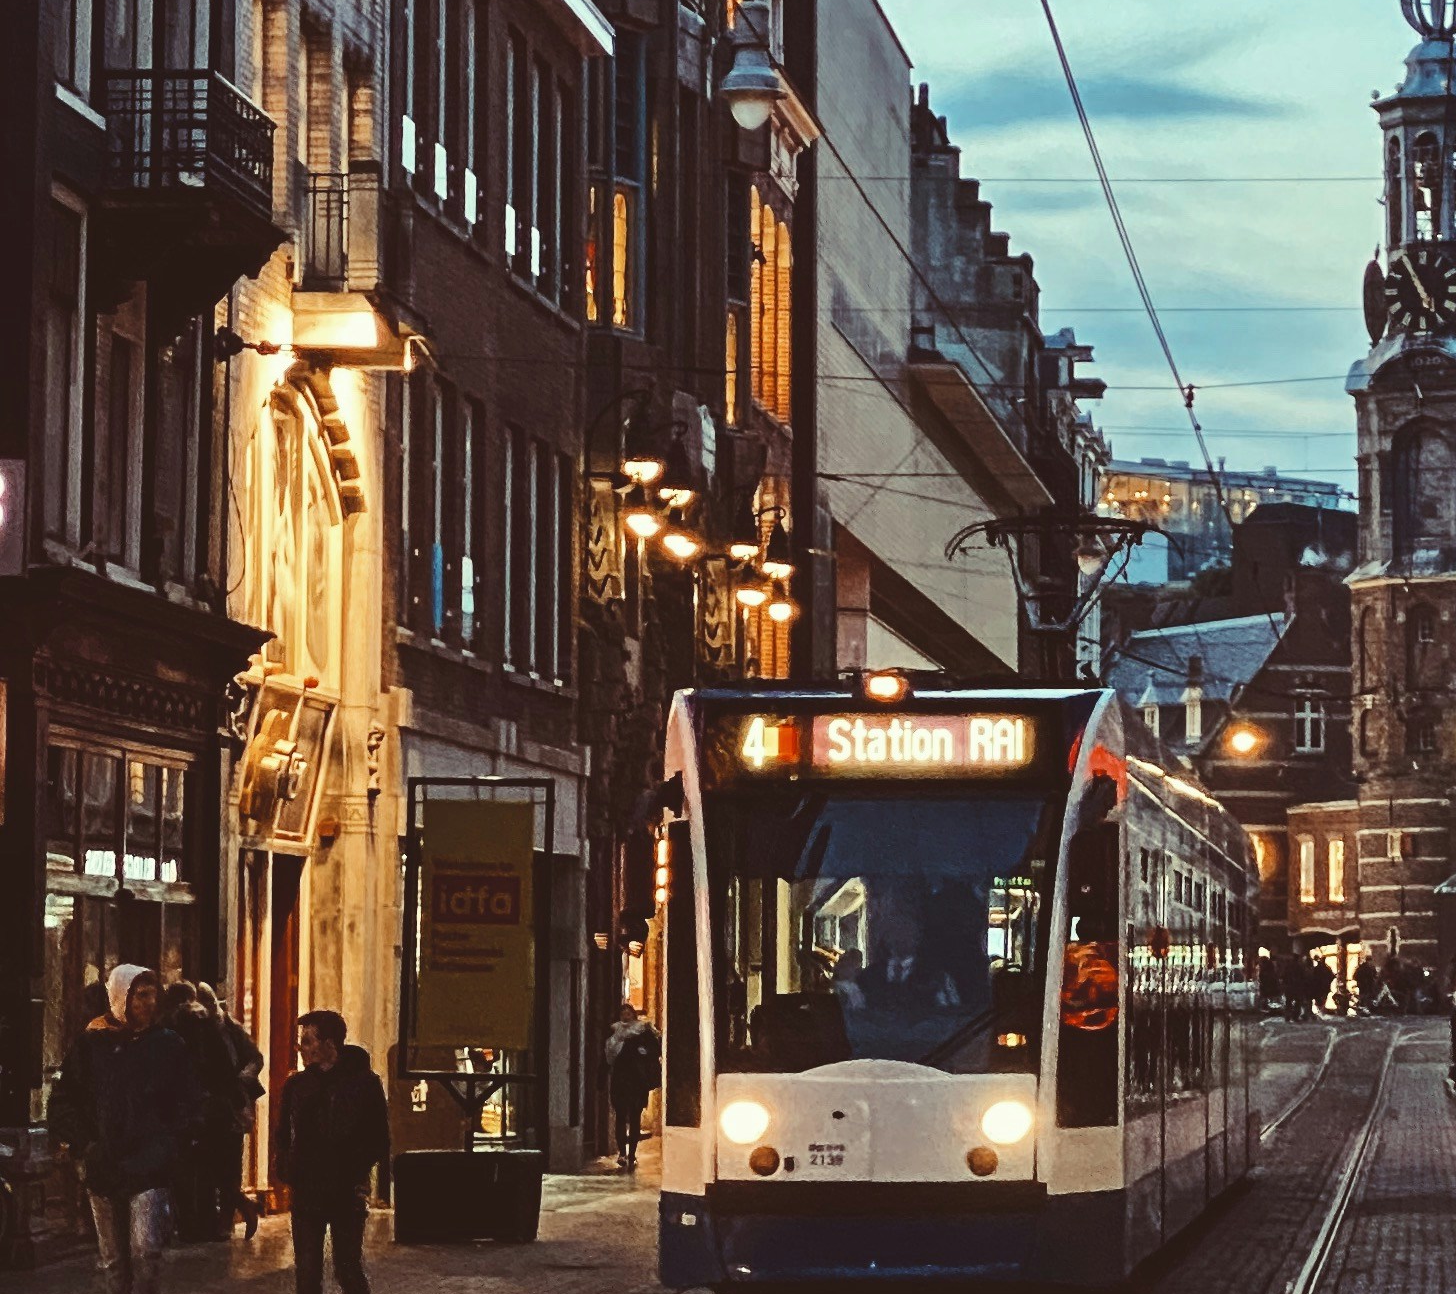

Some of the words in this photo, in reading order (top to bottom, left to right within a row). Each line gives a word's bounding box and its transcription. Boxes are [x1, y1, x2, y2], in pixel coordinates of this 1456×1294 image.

[742, 717, 765, 767] 4
[827, 717, 953, 763] Station
[969, 717, 1025, 763] RAI
[438, 884, 513, 917] idfa
